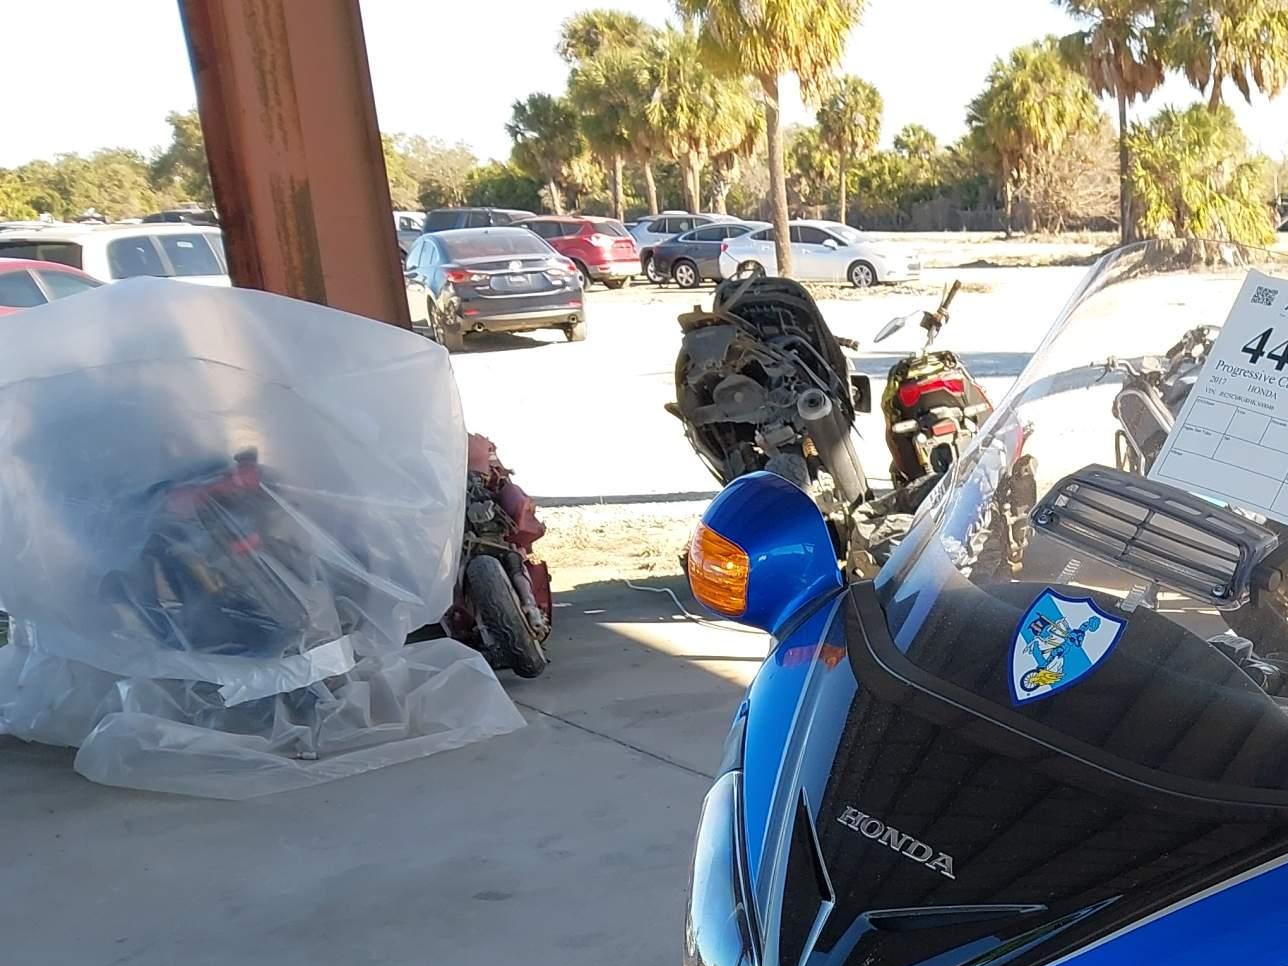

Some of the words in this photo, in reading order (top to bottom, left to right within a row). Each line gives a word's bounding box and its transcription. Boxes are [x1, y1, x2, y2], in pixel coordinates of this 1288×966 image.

[1209, 375, 1228, 386] 2017
[1215, 359, 1276, 385] Progressive
[1247, 383, 1278, 400] HONDA
[837, 805, 956, 880] HONDA
